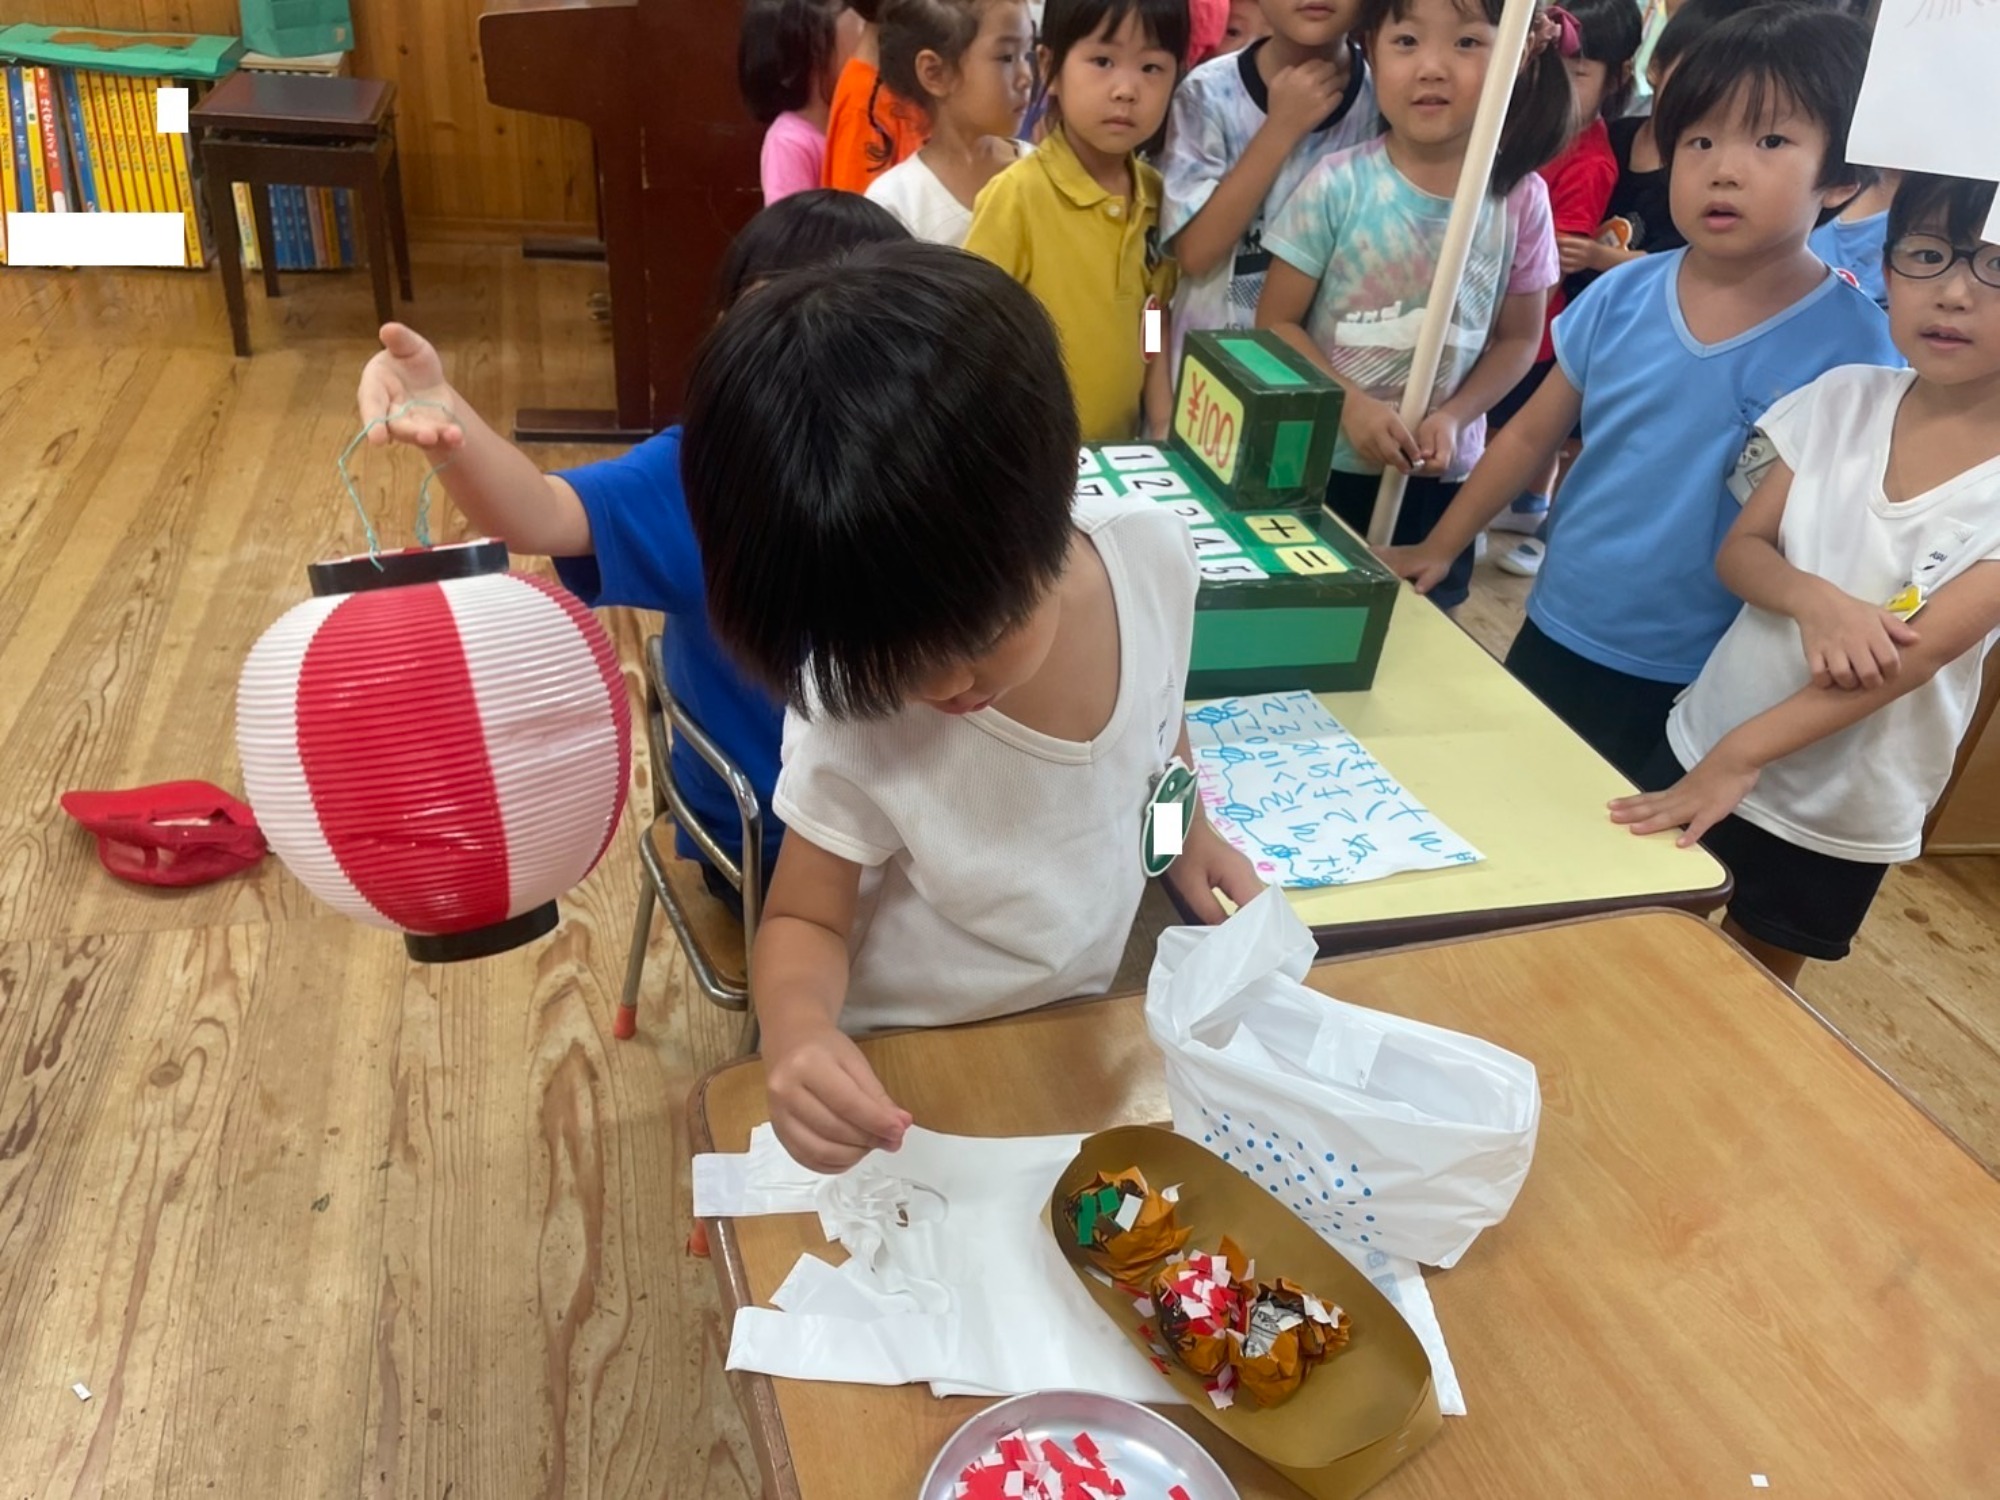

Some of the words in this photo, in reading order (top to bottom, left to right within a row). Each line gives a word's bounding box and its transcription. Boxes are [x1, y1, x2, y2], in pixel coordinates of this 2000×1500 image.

[1185, 371, 1235, 469] ¥100
[1132, 478, 1174, 491] 2
[1201, 565, 1251, 575] 5
